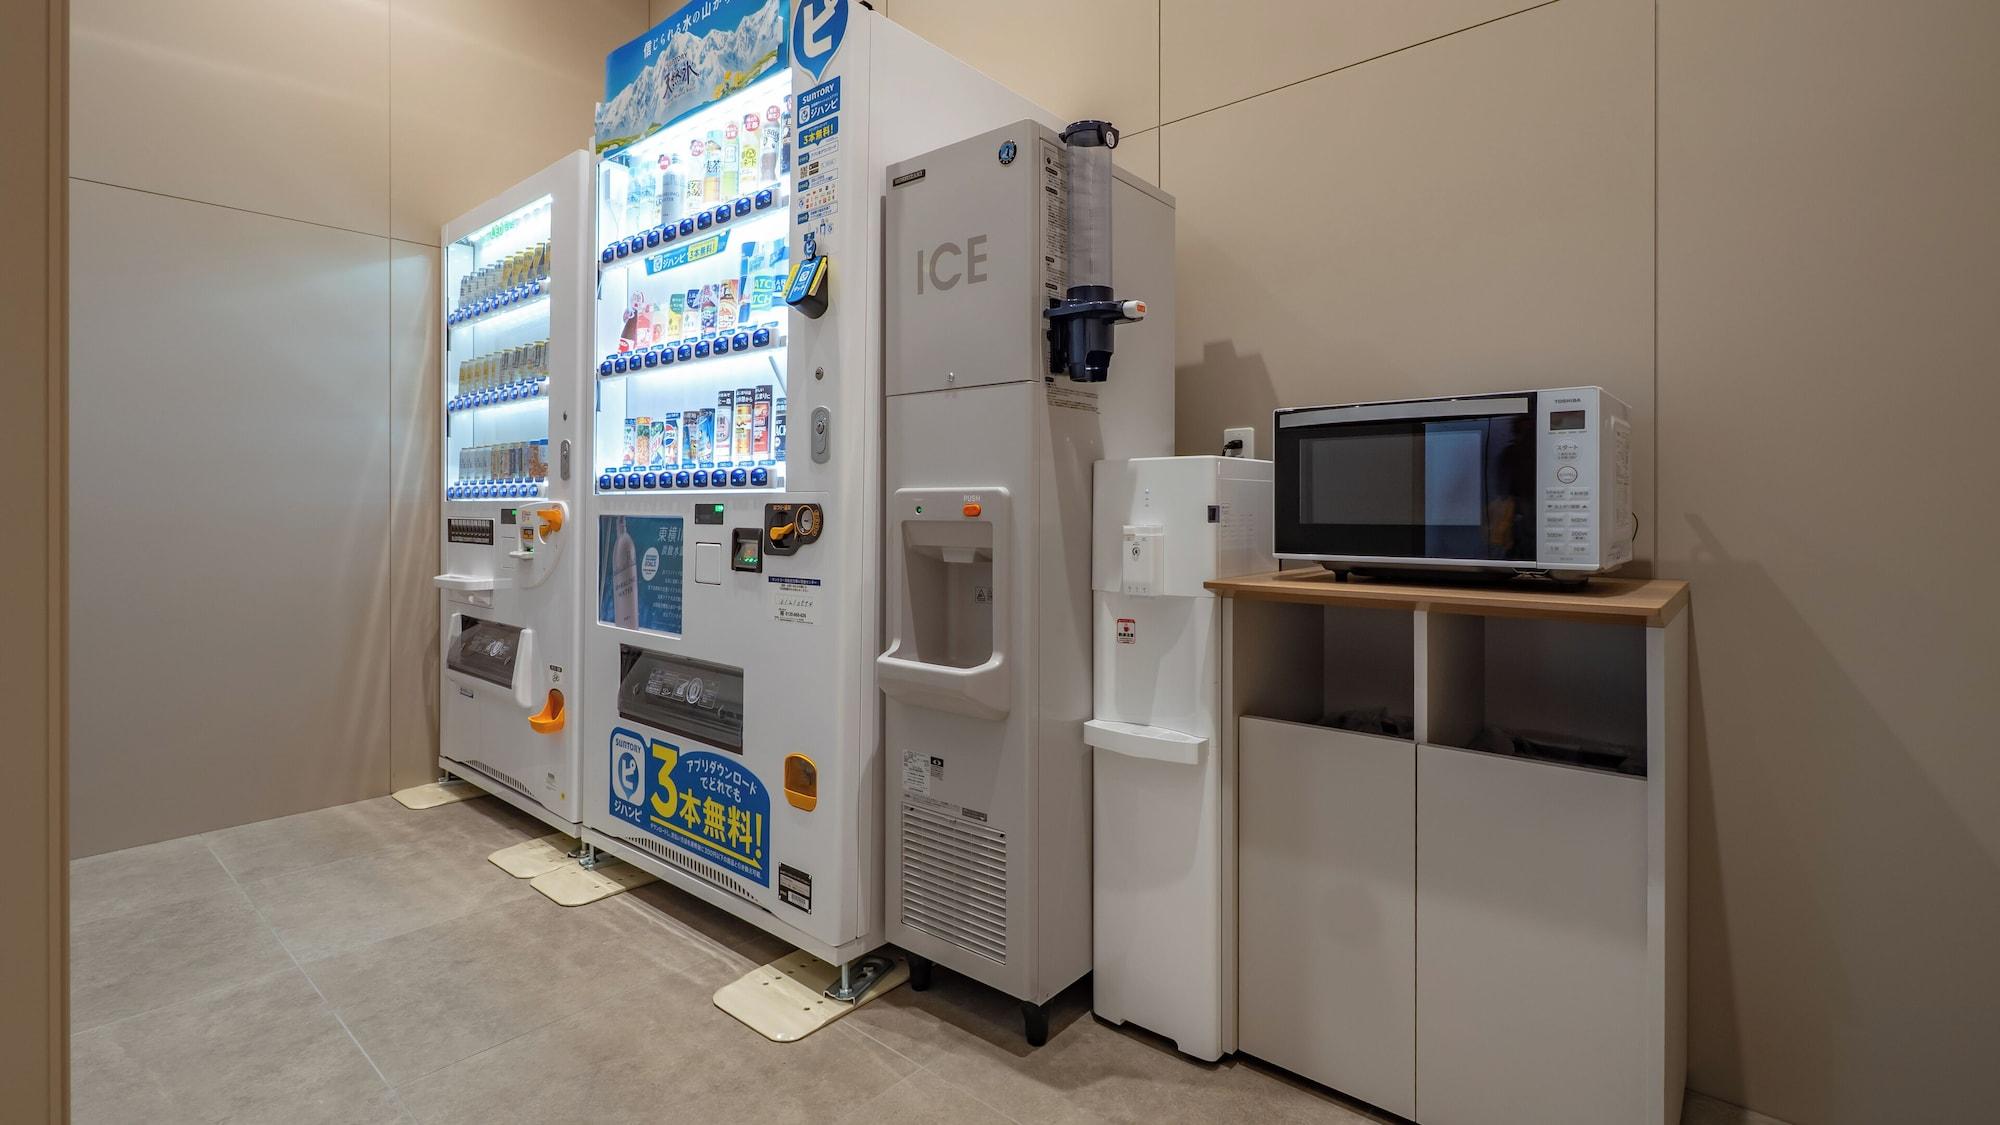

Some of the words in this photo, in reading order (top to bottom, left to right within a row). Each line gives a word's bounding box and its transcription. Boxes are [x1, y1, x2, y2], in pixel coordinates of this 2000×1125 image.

[644, 0, 731, 59] 信じられる水の山か
[803, 0, 838, 58] ピ
[802, 83, 835, 104] SUNTORY
[916, 234, 988, 295] ICE
[616, 738, 642, 754] SUNTORY
[622, 757, 636, 790] ピ
[686, 759, 758, 795] アプリダウンロード
[700, 777, 742, 803] でどれでも
[650, 743, 763, 859] 3本無料!
